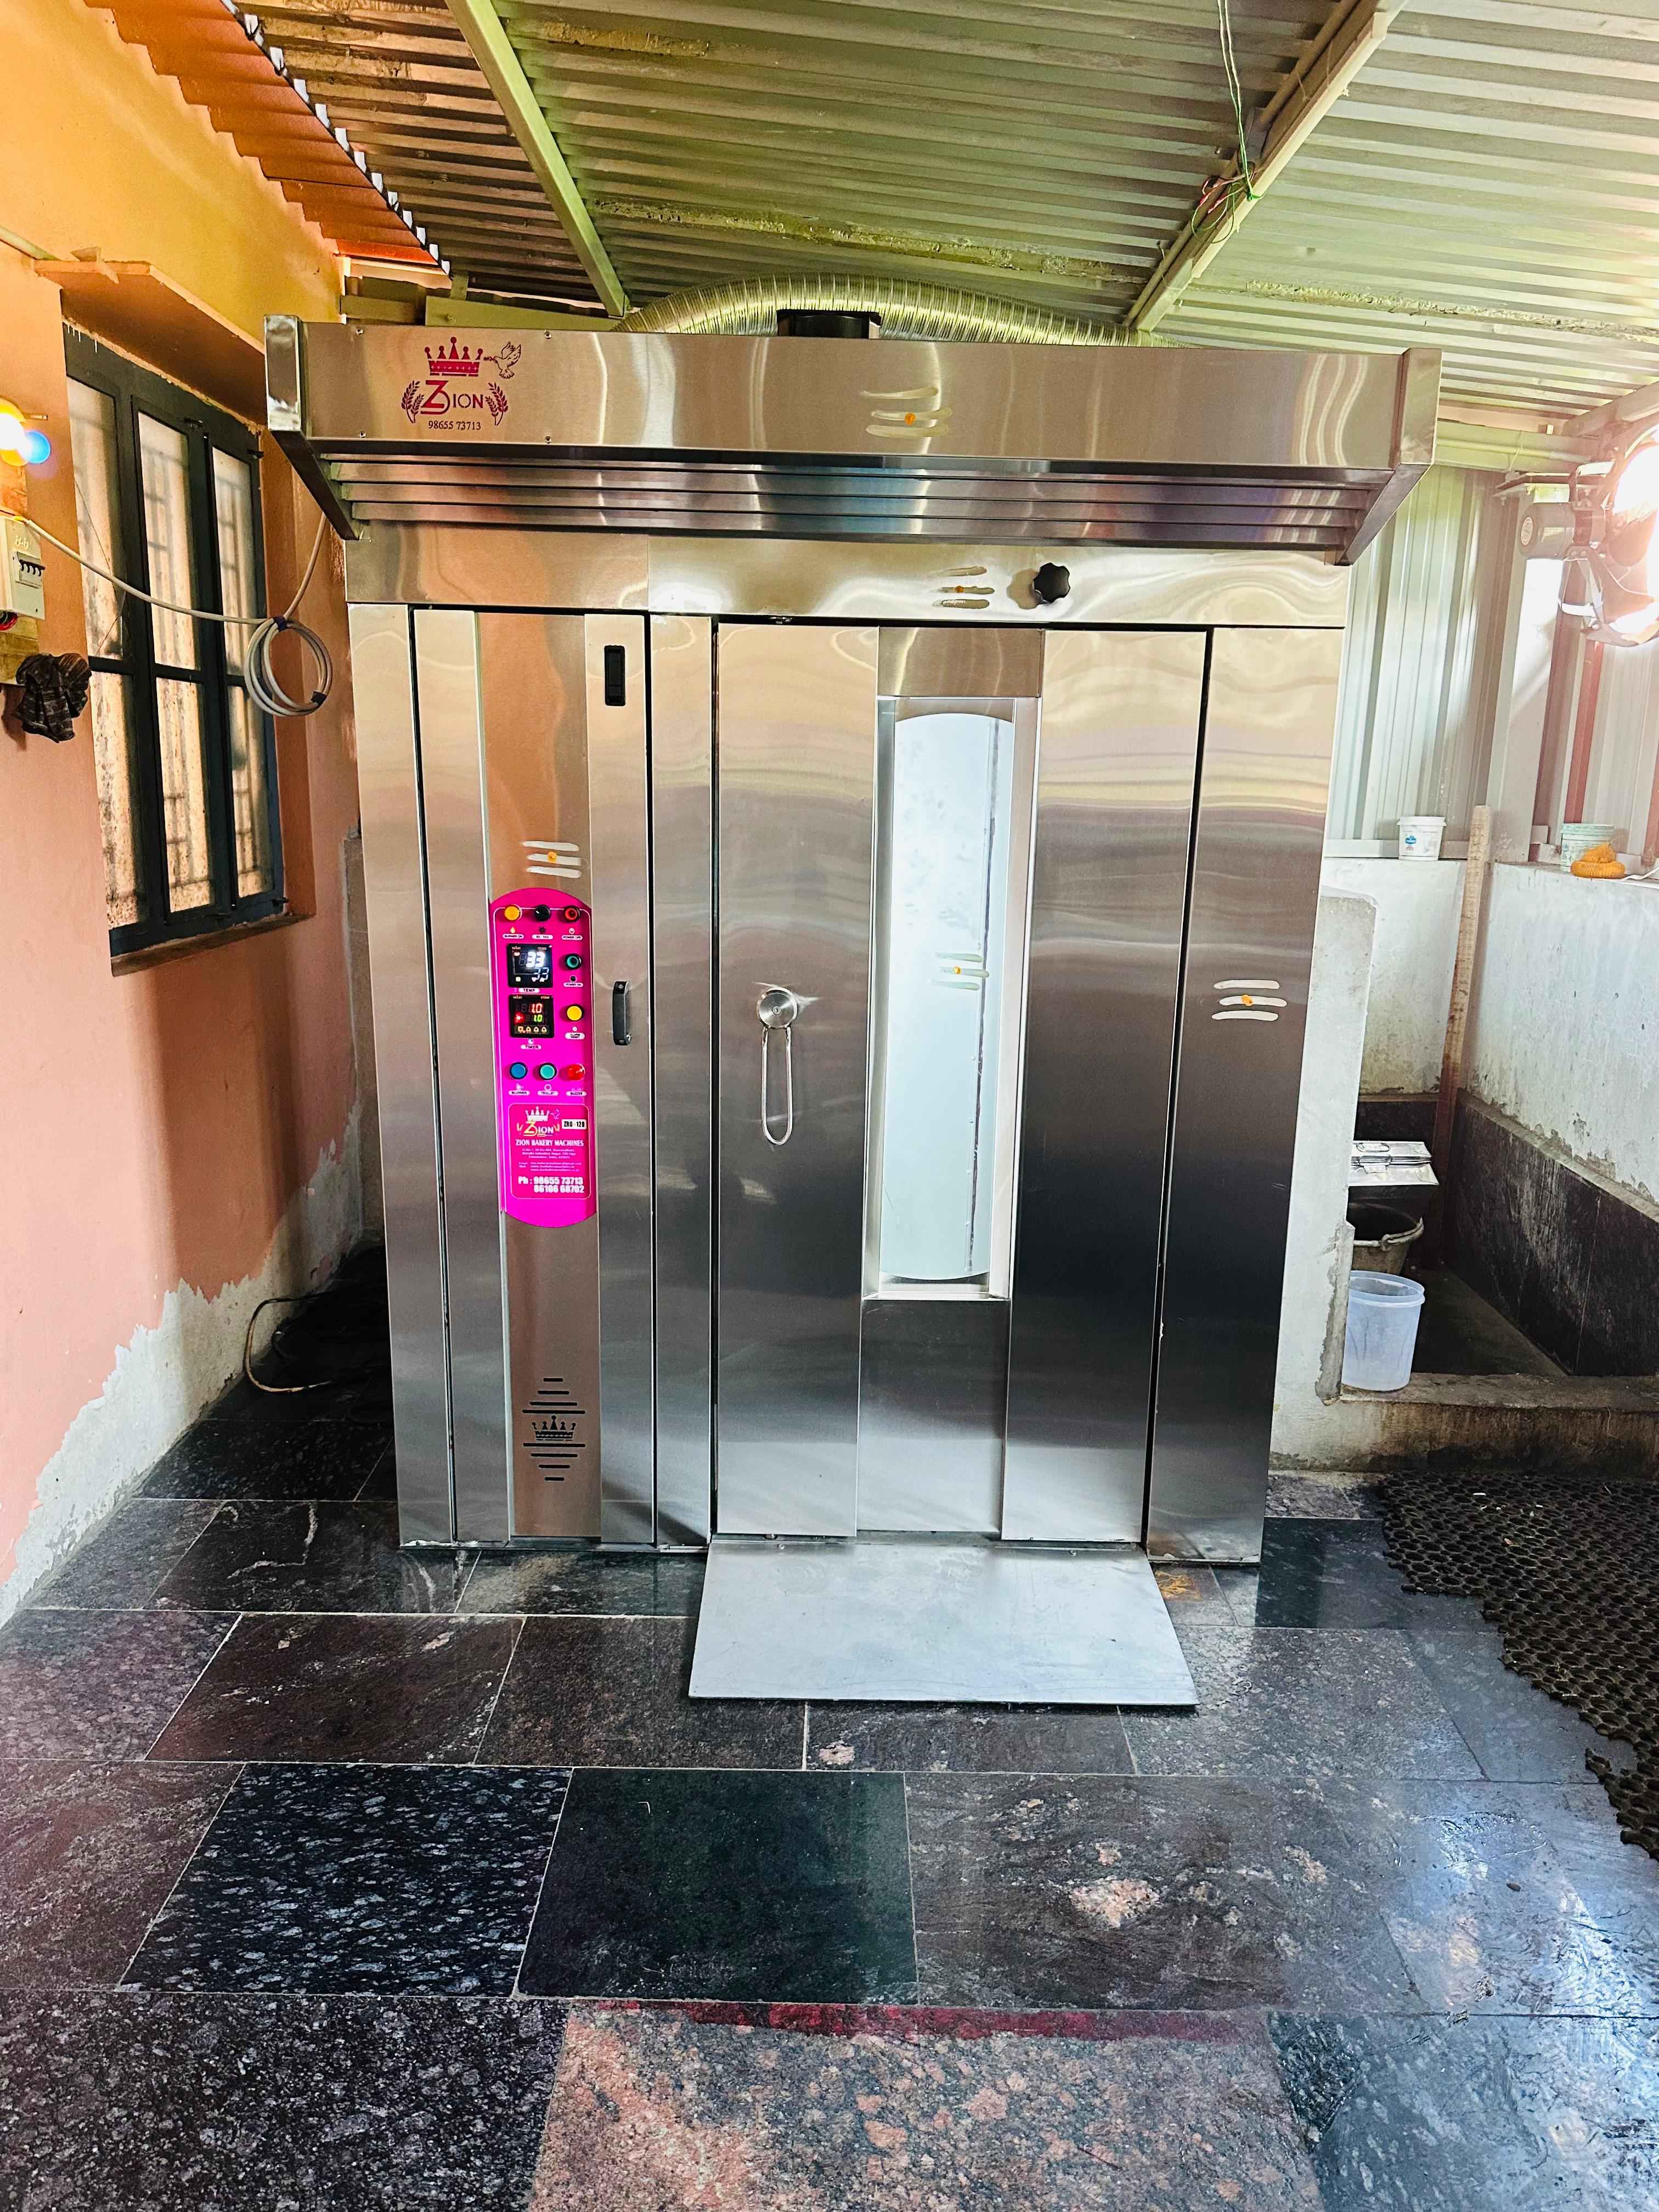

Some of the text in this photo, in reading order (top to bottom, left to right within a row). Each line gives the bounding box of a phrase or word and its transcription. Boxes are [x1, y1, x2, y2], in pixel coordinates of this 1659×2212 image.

[428, 420, 481, 430] 98655 73713
[526, 951, 546, 968] 33
[517, 1176, 529, 1184] Ph
[533, 1176, 560, 1185] 98655
[561, 1176, 584, 1185] 73713
